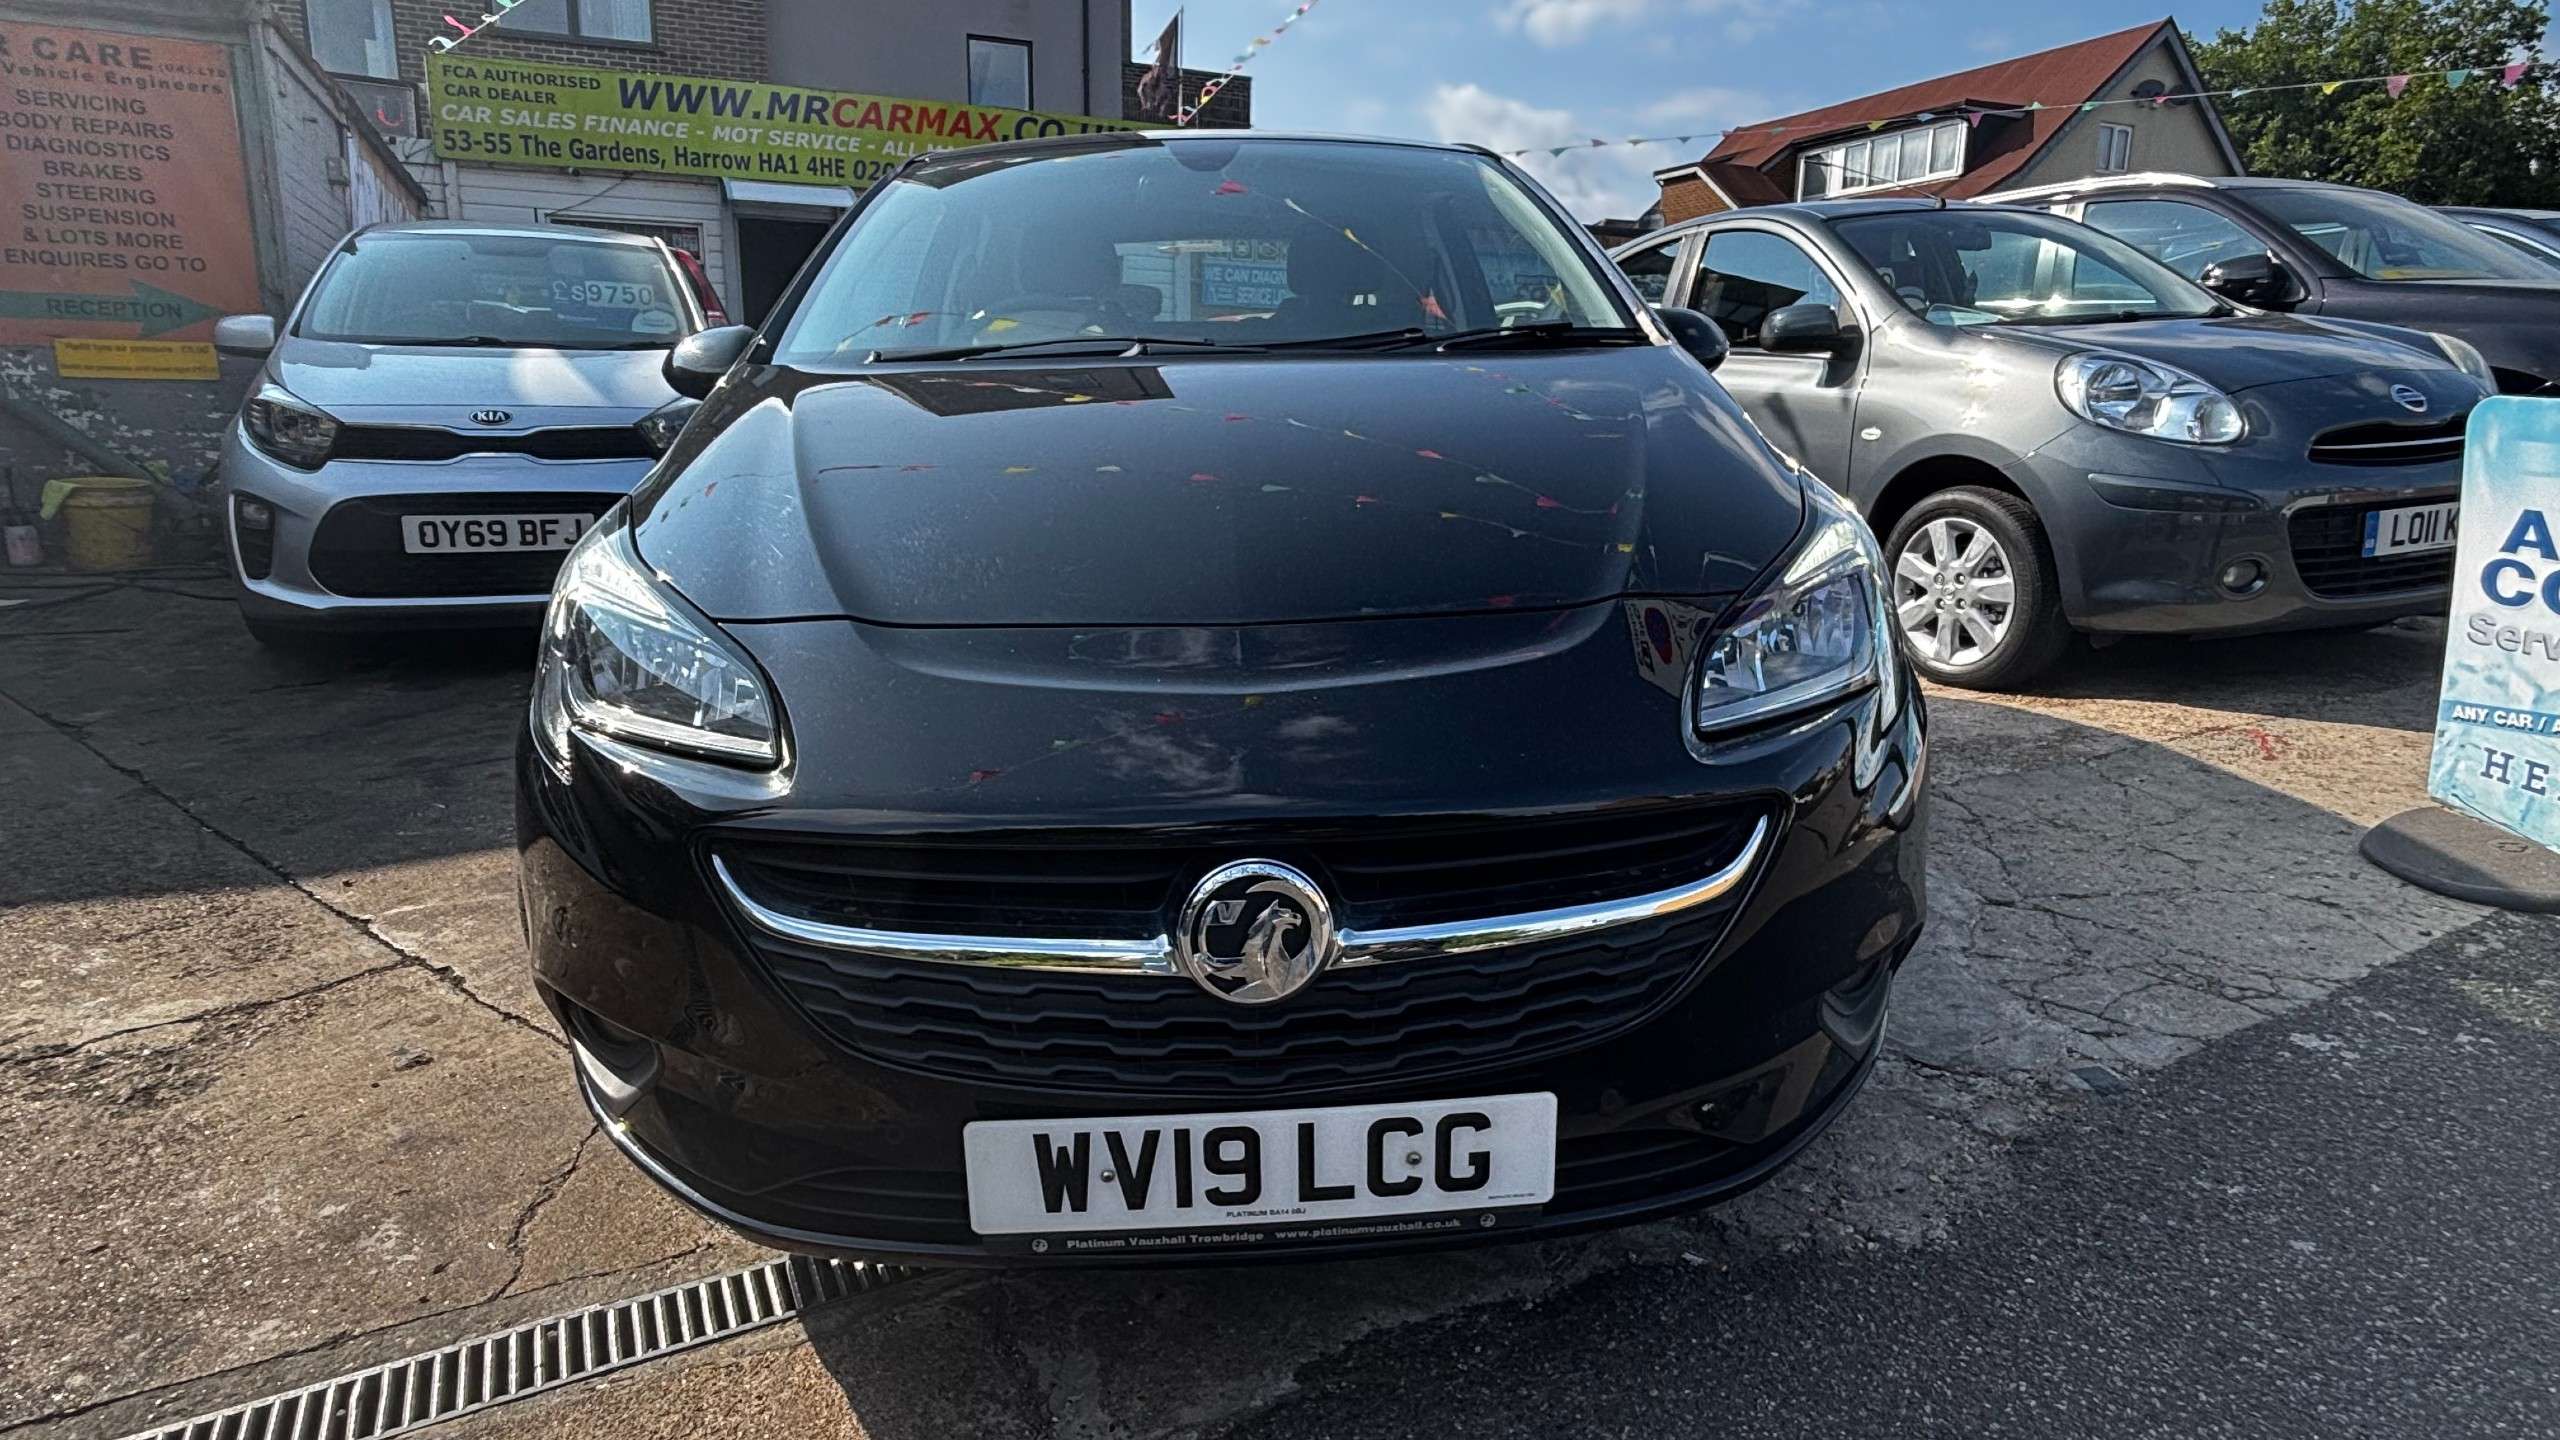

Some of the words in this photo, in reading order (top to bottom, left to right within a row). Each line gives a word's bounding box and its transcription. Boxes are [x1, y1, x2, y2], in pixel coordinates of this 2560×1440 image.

[32, 36, 153, 70] CARE
[1, 61, 95, 82] Vehicle
[105, 70, 224, 95] Engineers
[442, 64, 478, 80] FCA
[484, 68, 601, 90] AUTHORISED
[16, 88, 147, 116] SERVICING
[444, 84, 481, 99] CAR
[487, 87, 557, 105] DEALER
[618, 77, 1131, 142] WWW.MRCARMAX.CO
[0, 110, 62, 131] BODY
[72, 116, 175, 141] REPAIRS
[441, 104, 492, 123] CAR
[499, 108, 577, 130] SALES
[584, 114, 690, 139] FINANCE
[712, 125, 763, 144] MOT
[768, 129, 861, 153] SERVICE
[882, 140, 918, 157] ALL
[6, 133, 171, 162] DIAGNOSTICS
[443, 129, 512, 155] 53-55
[519, 134, 562, 158] The
[568, 138, 666, 169] Gardens,
[674, 145, 752, 171] Harrow
[759, 152, 799, 174] HA1
[806, 156, 845, 178] 4HE
[44, 160, 144, 182] BRAKES
[36, 182, 156, 205] STEERING
[22, 204, 177, 228] SUSPENSION
[23, 226, 39, 243] &
[47, 229, 108, 246] LOTS
[116, 231, 184, 250] MORE
[5, 248, 128, 270] ENQUIRES
[135, 255, 170, 271] GO
[176, 256, 207, 273] TO
[46, 298, 183, 320] RECEPTION
[477, 410, 506, 422] KIA
[417, 519, 508, 548] OY69
[517, 518, 583, 547] BFJ
[2452, 704, 2489, 724] ANY
[2493, 709, 2535, 730] CAR
[2480, 746, 2560, 801] HE
[1032, 1125, 1262, 1214] WV19
[1297, 1111, 1493, 1204] LCG
[1066, 1237, 1126, 1250] Platinum
[1129, 1234, 1187, 1247] Vauxhall
[1189, 1231, 1265, 1245] Trowbridge
[1275, 1218, 1462, 1239] www.platinumvauxhall.co.uk
